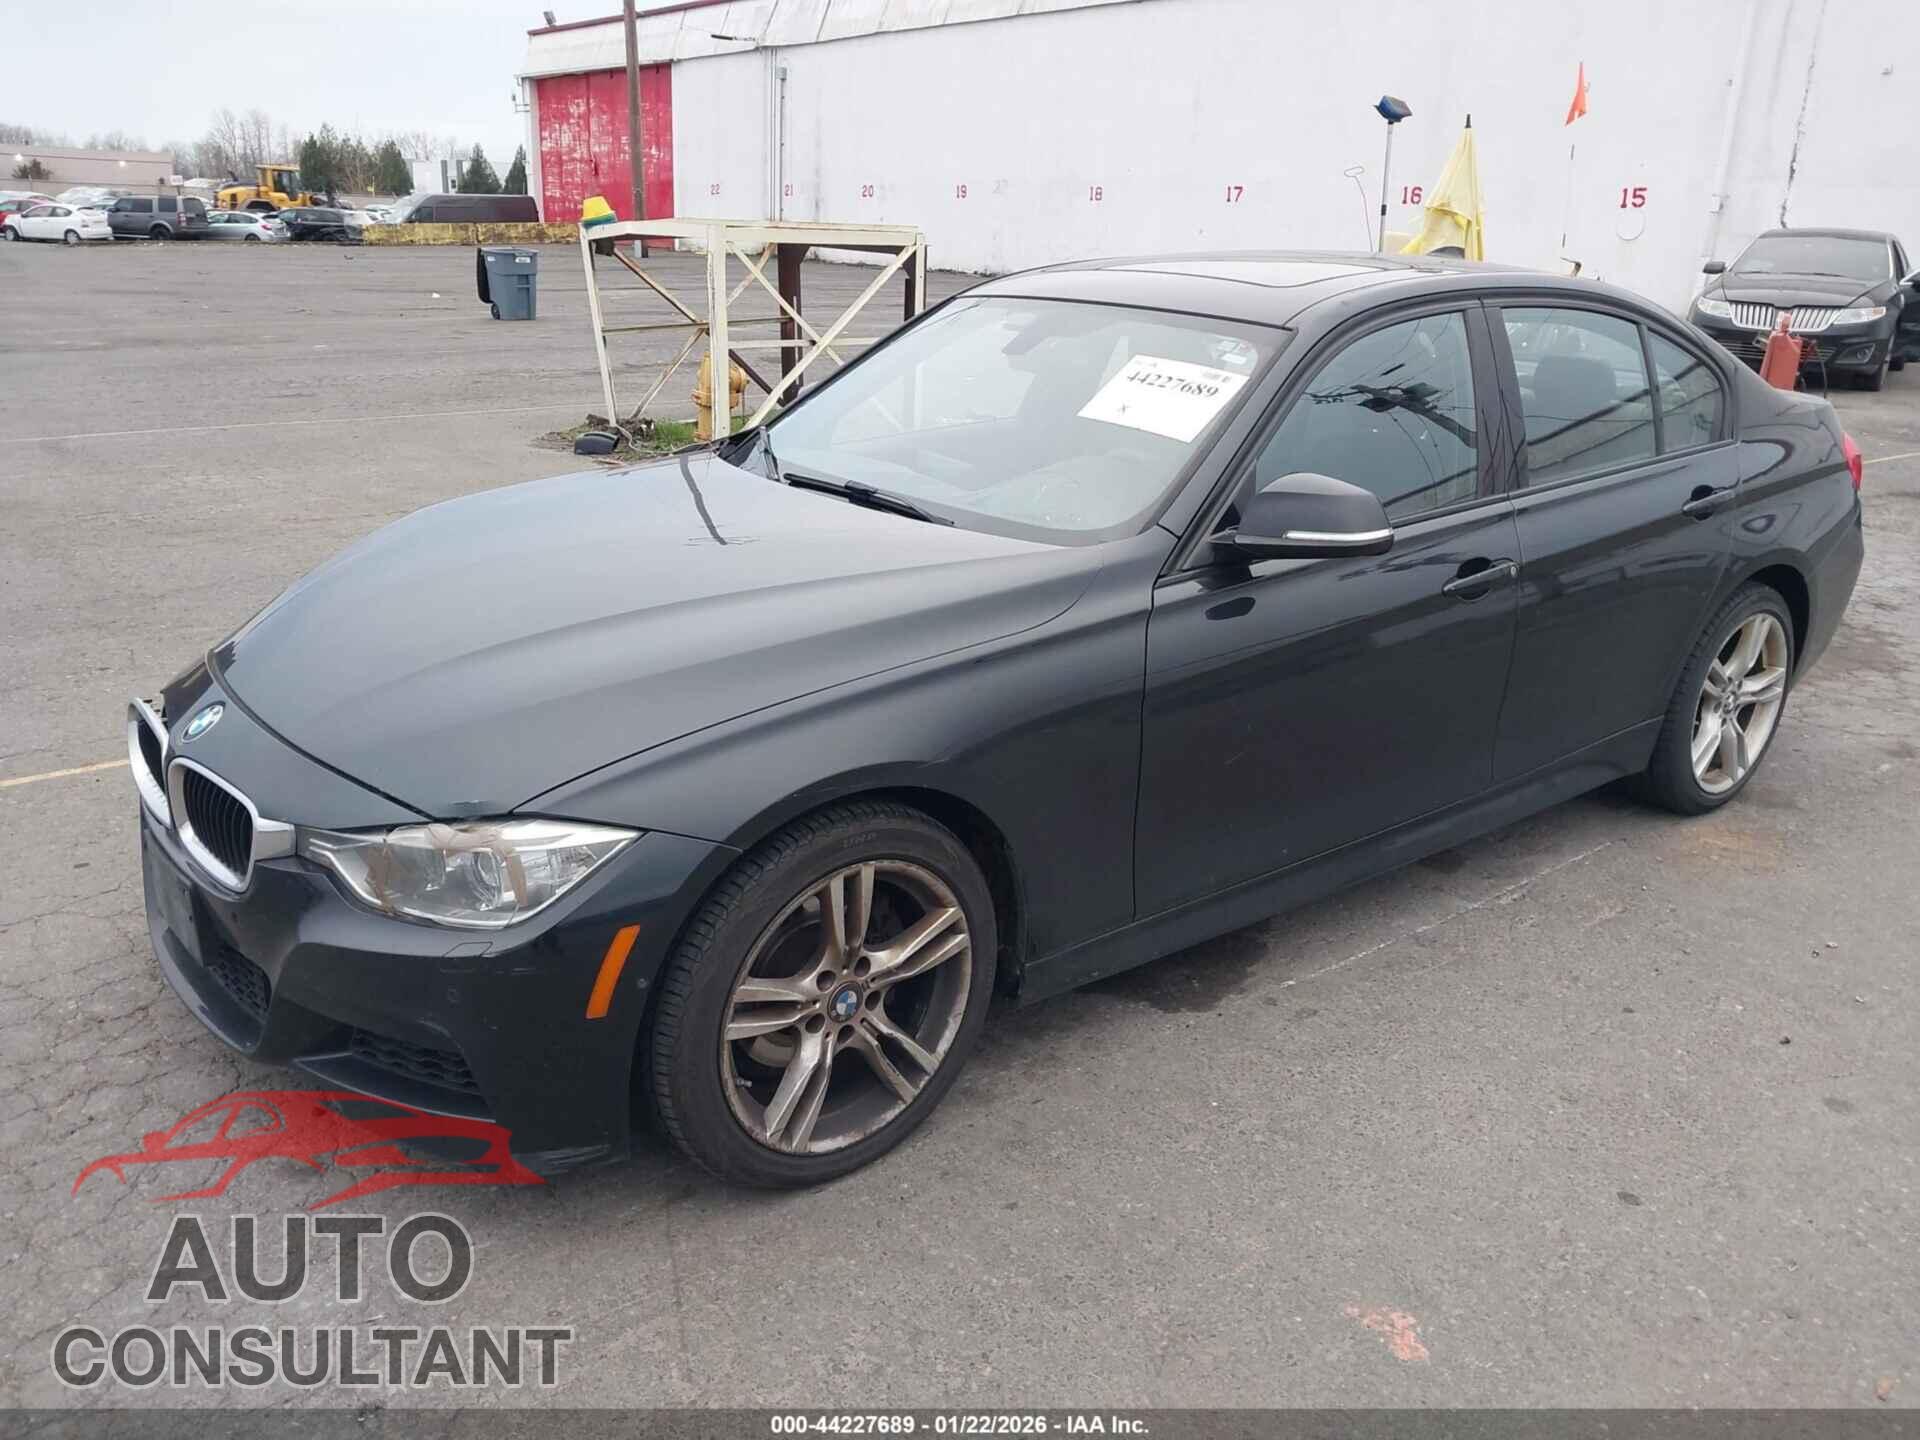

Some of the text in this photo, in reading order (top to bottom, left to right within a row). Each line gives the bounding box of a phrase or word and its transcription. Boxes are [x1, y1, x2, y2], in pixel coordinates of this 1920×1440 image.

[710, 183, 721, 196] 22
[784, 183, 794, 197] 21
[861, 184, 874, 198] 20
[956, 184, 968, 199] 19
[1089, 186, 1103, 202] 18
[1226, 186, 1244, 203] 17
[1402, 186, 1423, 205] 16
[1620, 187, 1648, 209] 15
[1126, 370, 1220, 399] 44227689
